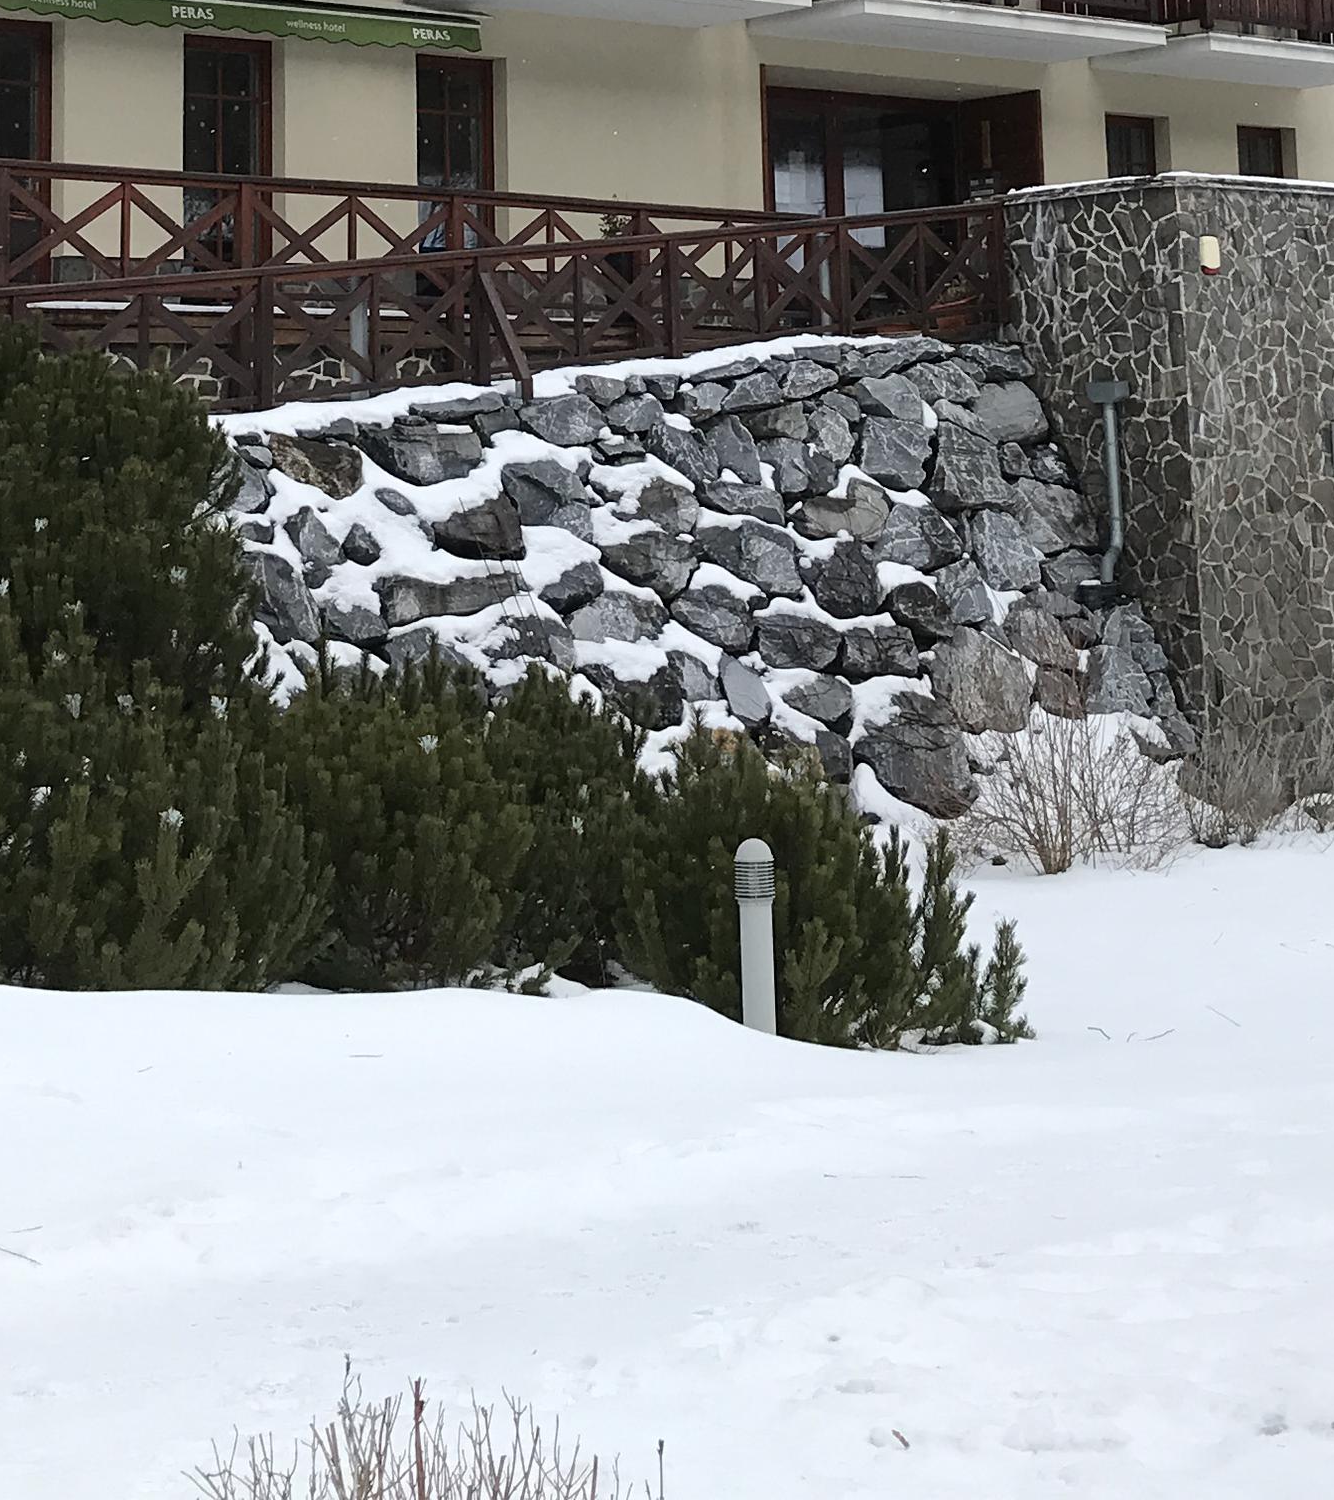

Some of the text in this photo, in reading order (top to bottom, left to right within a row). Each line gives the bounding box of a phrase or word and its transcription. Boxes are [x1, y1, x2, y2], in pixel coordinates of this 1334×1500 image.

[171, 6, 214, 20] PERAS
[285, 19, 346, 32] wellness hotel
[412, 27, 451, 41] PERAS
